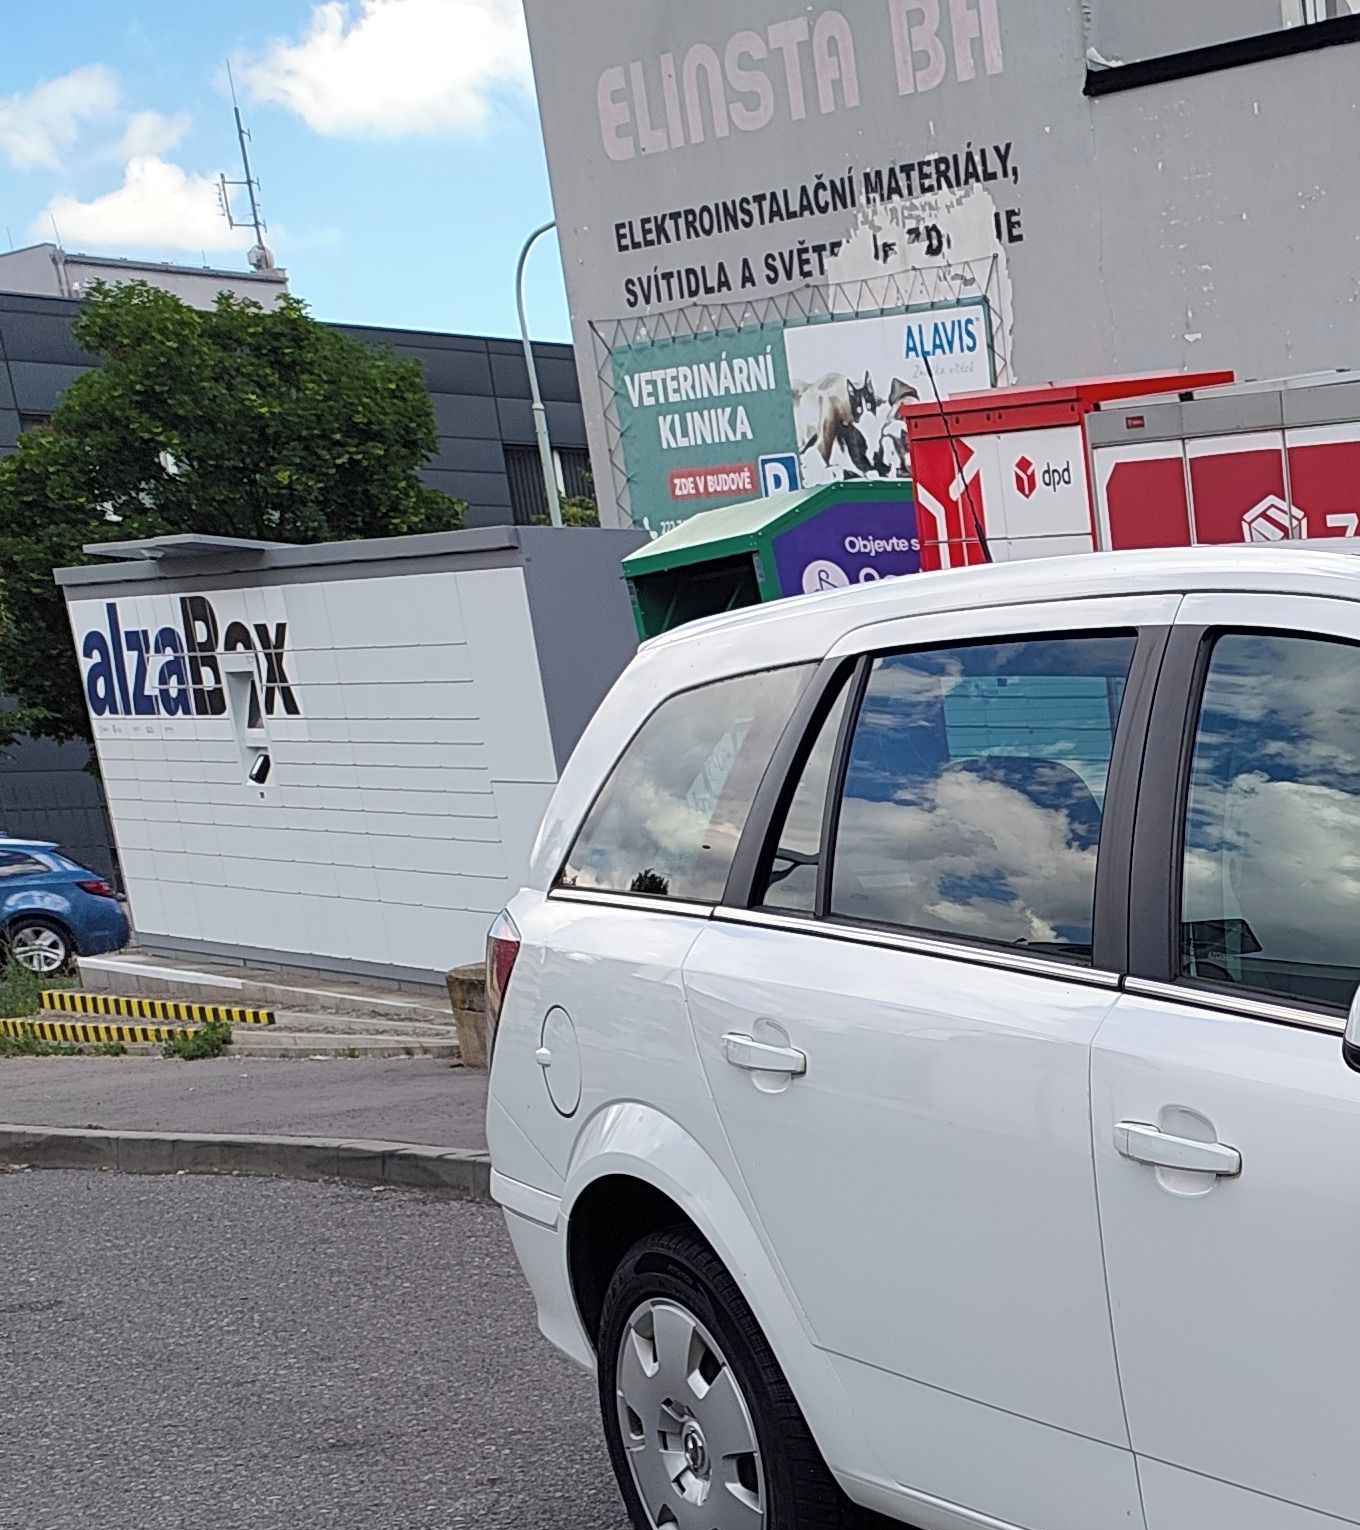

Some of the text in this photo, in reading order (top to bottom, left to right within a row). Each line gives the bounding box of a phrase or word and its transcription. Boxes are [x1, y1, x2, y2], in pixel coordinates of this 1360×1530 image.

[597, 10, 861, 161] ELINSTA
[614, 142, 1019, 252] ELEKTROINSTALAČNÍ MATERIÁLY,
[625, 265, 732, 308] SVÍTIDLA
[741, 257, 756, 289] A
[905, 317, 977, 359] ALAVIS
[624, 345, 776, 408] VETERINÁRNÍ
[658, 405, 753, 449] KLINIKA
[673, 477, 695, 496] ZDE
[696, 475, 705, 494] V
[1042, 460, 1072, 493] dpd
[844, 535, 909, 557] Objevte
